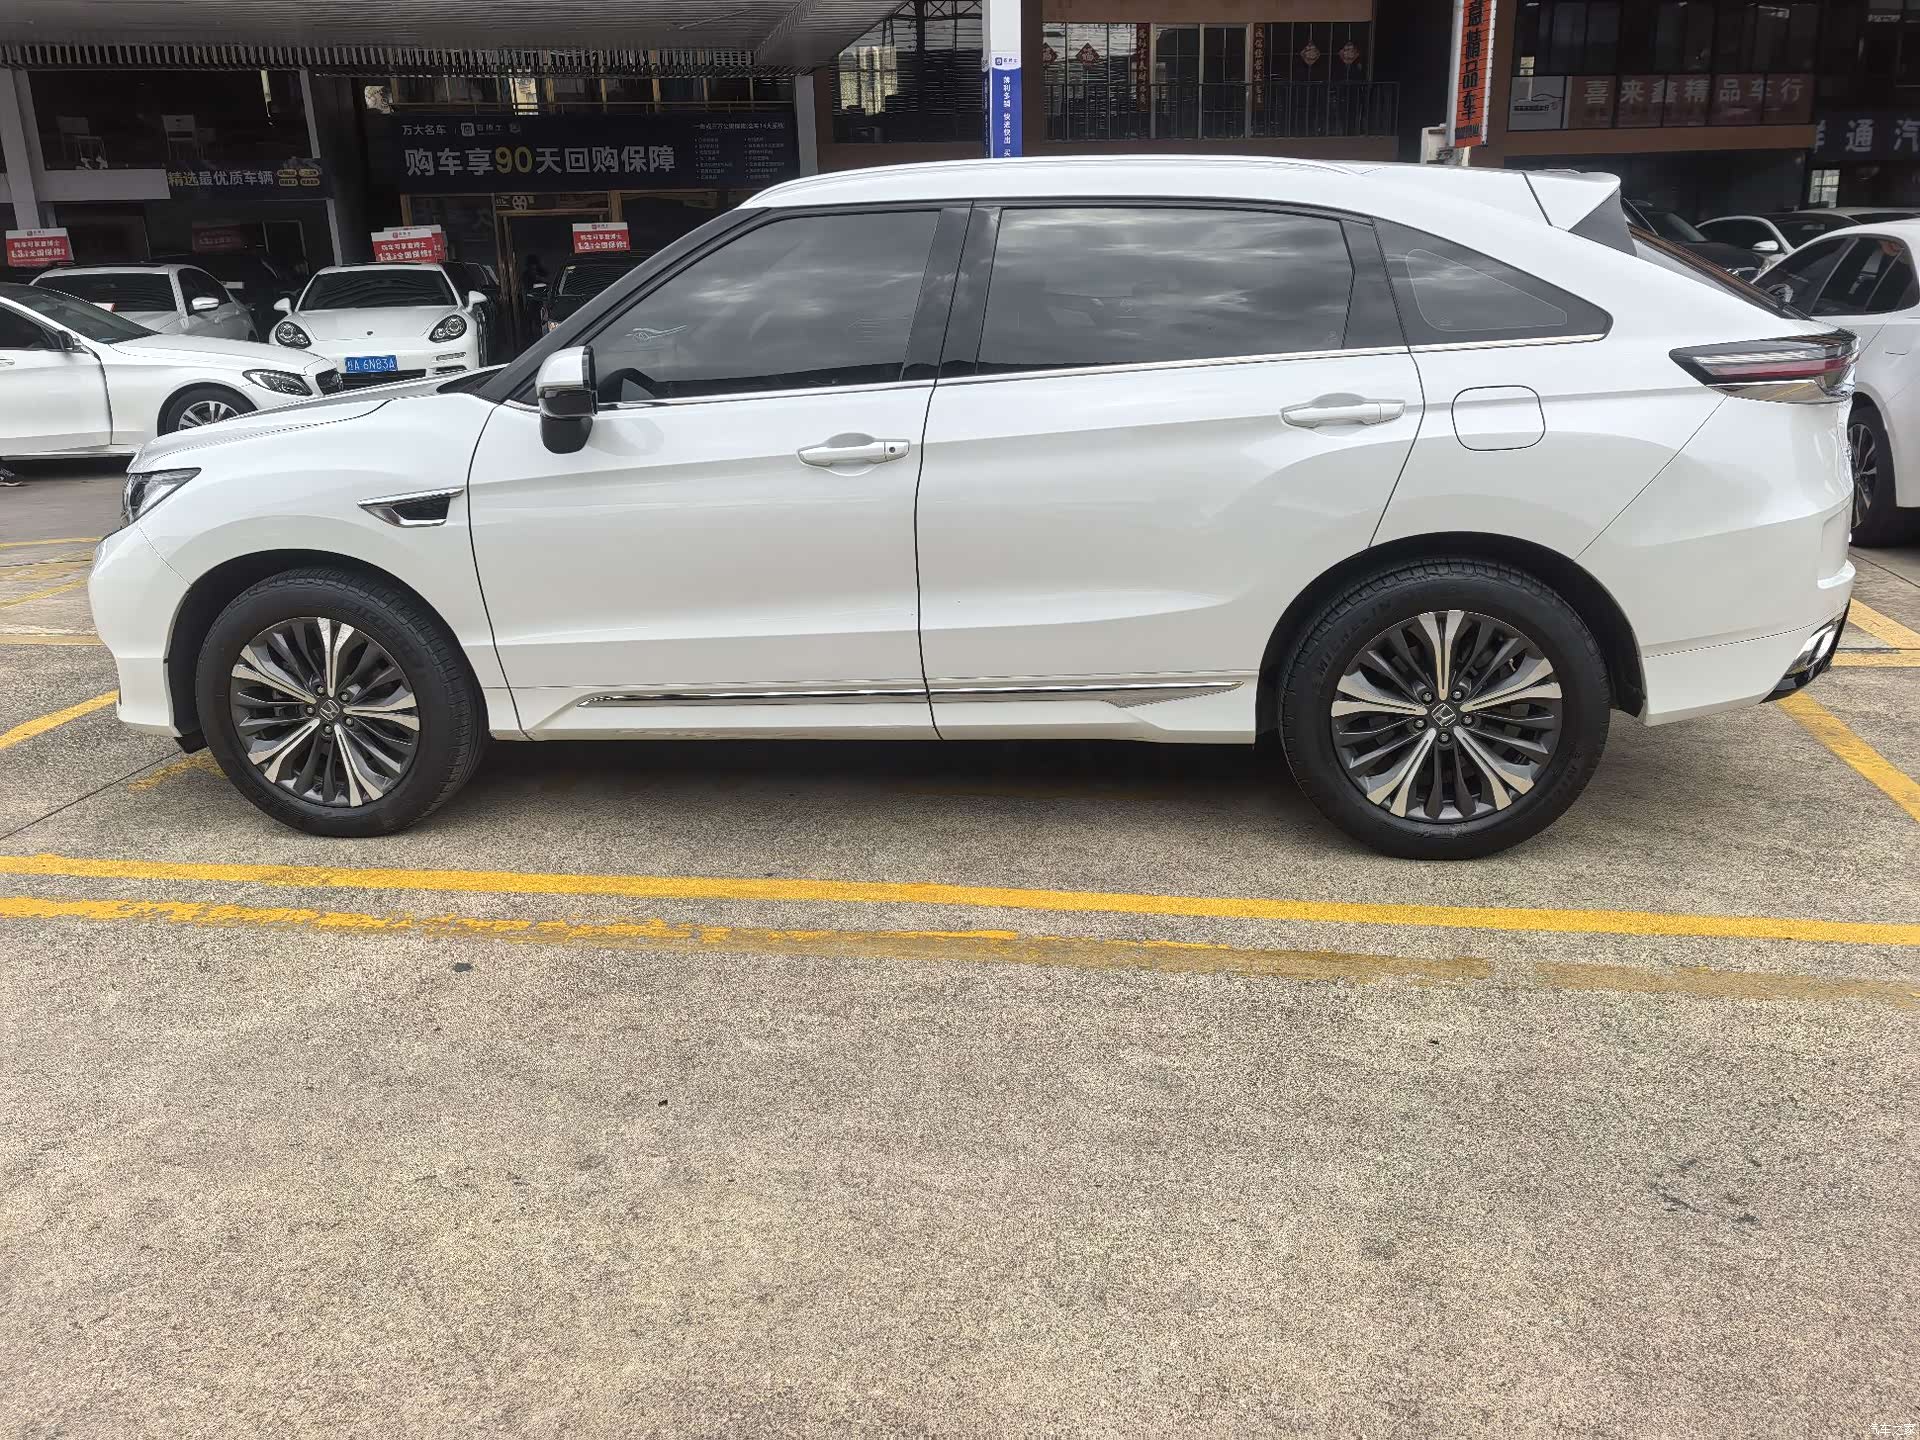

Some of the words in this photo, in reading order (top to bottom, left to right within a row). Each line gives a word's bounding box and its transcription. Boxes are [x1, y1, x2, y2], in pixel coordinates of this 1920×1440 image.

[1584, 78, 1803, 104] 喜来鑫精品车行
[402, 124, 447, 136] 万大名车
[405, 145, 675, 176] 购车享90天回购保障
[167, 170, 274, 187] 精选最优质车辆
